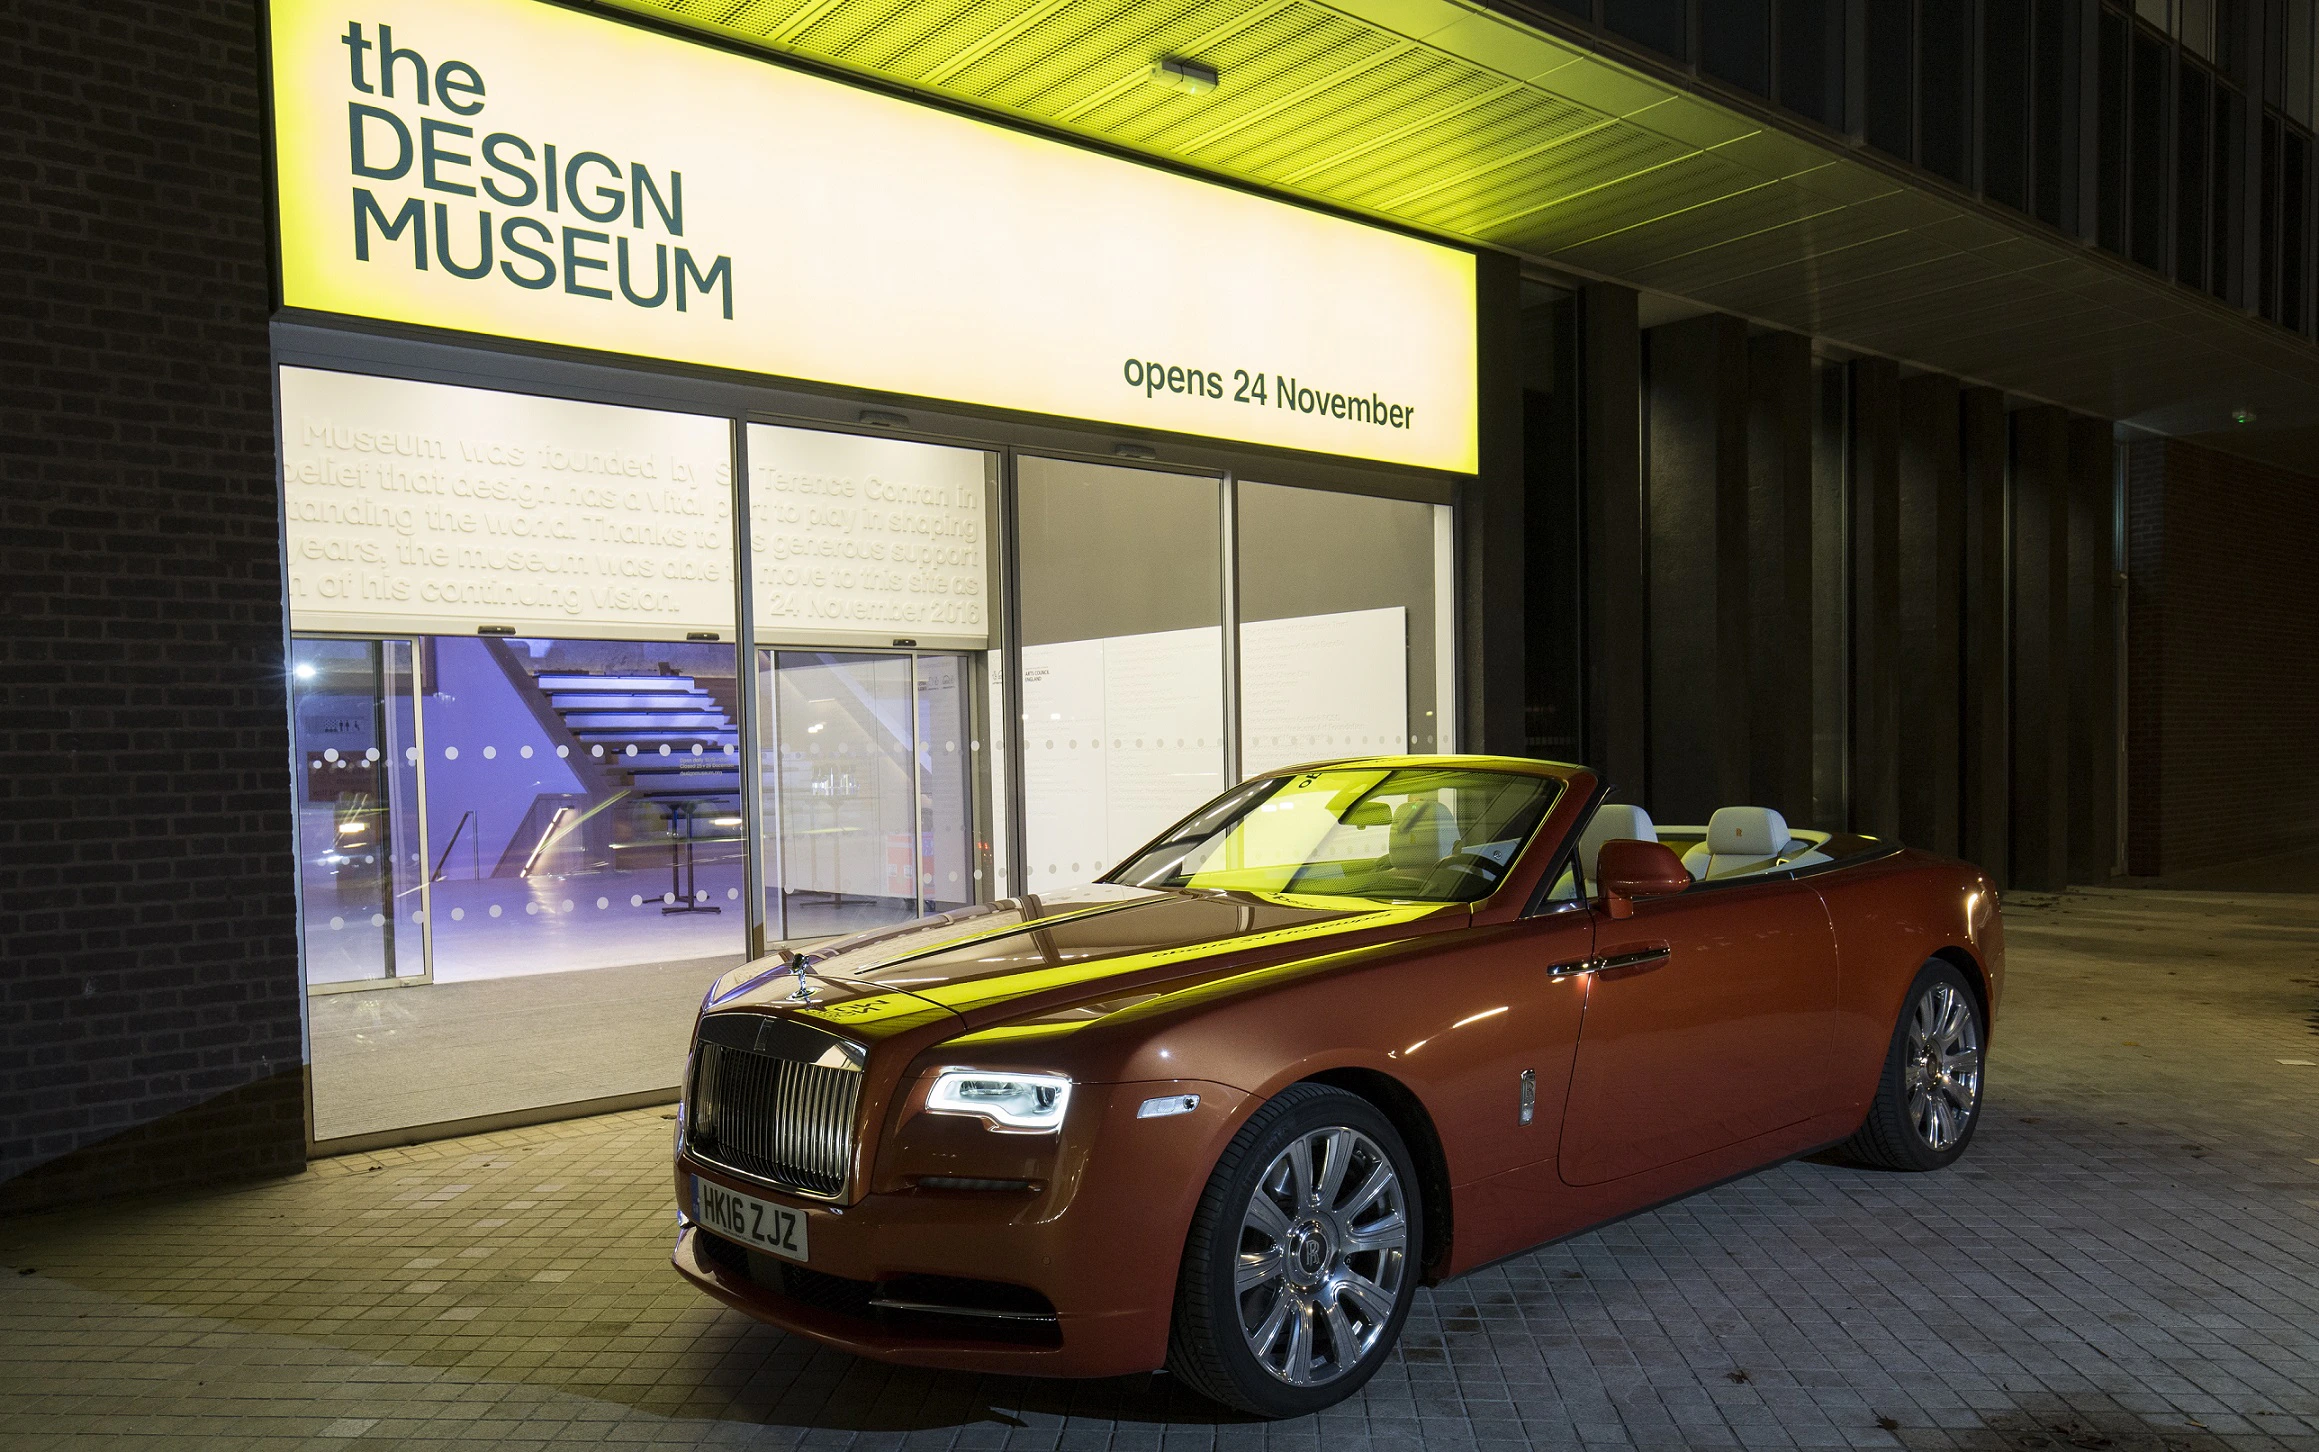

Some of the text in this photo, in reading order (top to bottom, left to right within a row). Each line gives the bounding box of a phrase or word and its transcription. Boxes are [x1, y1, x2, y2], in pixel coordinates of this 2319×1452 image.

[341, 20, 486, 116] the
[348, 101, 684, 237] DESIGN
[352, 187, 734, 320] MUSEUM
[1123, 358, 1415, 430] opens 24 November
[303, 419, 447, 460] Museum
[458, 437, 526, 467] was
[538, 444, 658, 480] founded
[671, 455, 699, 490] by
[758, 466, 857, 498] Terence
[863, 473, 949, 508] Conran
[956, 484, 978, 510] in
[376, 460, 446, 495] that
[452, 469, 556, 510] design
[564, 477, 617, 509] has
[623, 487, 642, 511] a
[646, 485, 705, 516] vital
[774, 502, 800, 524] to
[806, 501, 858, 534] play
[862, 505, 883, 531] in
[888, 509, 978, 544] shaping
[425, 502, 477, 533] the
[582, 515, 688, 549] Thanks
[692, 529, 721, 550] to
[771, 531, 886, 562] generous
[890, 540, 979, 569] support
[317, 569, 353, 599] of
[361, 571, 412, 601] his
[421, 574, 583, 615] continuing
[396, 536, 450, 567] the
[457, 545, 589, 575] museum
[595, 552, 657, 578] was
[662, 553, 720, 582] able
[758, 564, 827, 586] move
[831, 565, 857, 589] to
[860, 565, 904, 592] this
[907, 570, 949, 595] site
[951, 575, 980, 596] as
[769, 590, 980, 625] 24 November 2016
[703, 1184, 798, 1252] HK16 ZJZ
